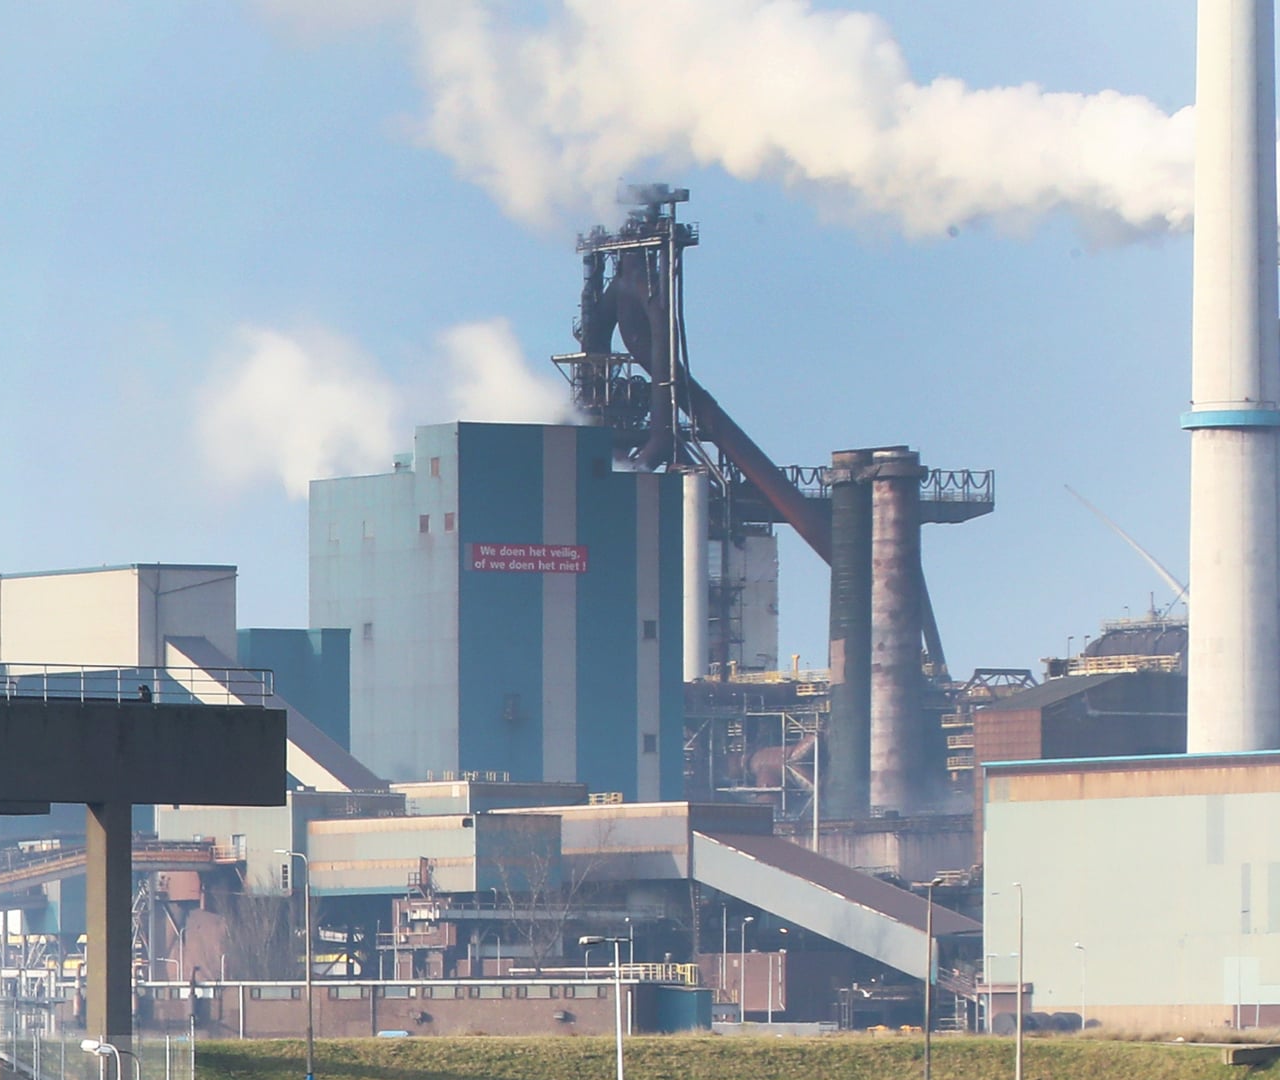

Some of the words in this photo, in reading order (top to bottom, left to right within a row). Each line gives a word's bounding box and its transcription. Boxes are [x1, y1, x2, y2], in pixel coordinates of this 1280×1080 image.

[480, 546, 496, 556] We
[500, 546, 525, 556] doen
[529, 546, 546, 557] het
[550, 547, 581, 560] veilig,
[474, 559, 486, 569] of
[490, 561, 505, 569] we
[509, 560, 534, 570] doen
[538, 560, 556, 570] het
[559, 561, 580, 571] niet
